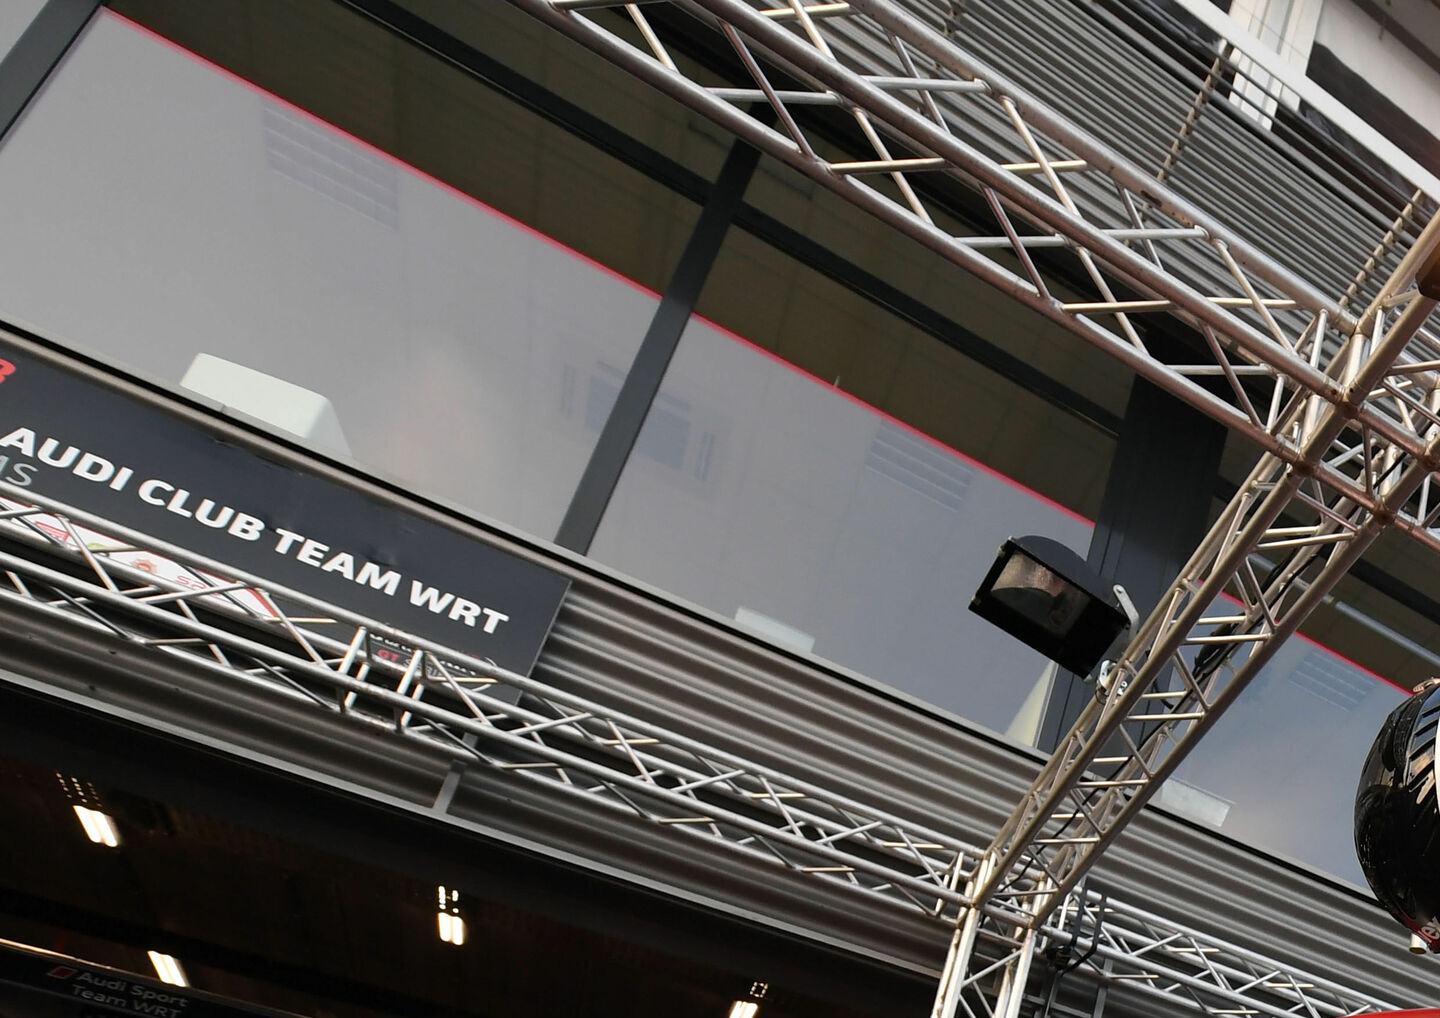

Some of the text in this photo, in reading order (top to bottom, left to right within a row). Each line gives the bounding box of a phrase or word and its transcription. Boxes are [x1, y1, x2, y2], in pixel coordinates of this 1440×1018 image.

[0, 427, 510, 635] AUDI CLUB TEAM WRT
[376, 649, 401, 663] GT
[72, 984, 182, 1018] Team WRT
[76, 972, 189, 1008] Audi Sport
